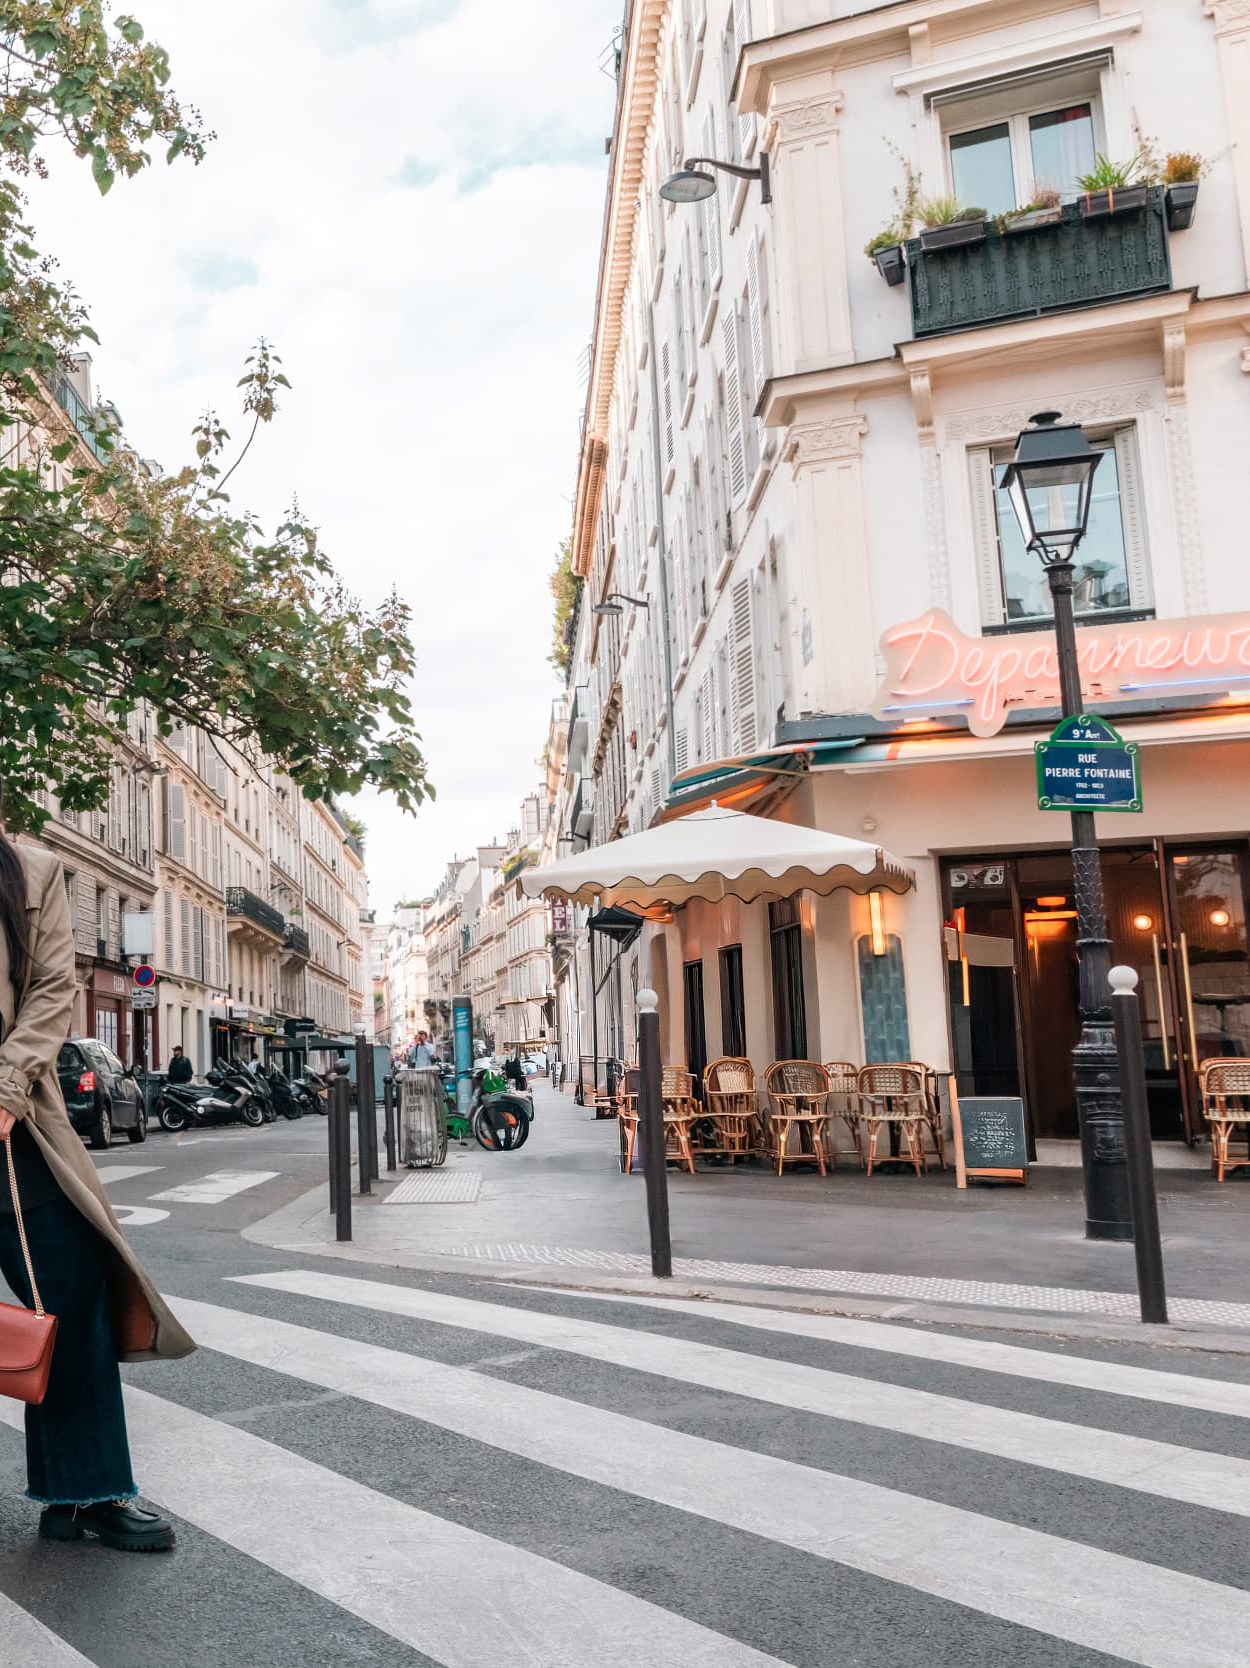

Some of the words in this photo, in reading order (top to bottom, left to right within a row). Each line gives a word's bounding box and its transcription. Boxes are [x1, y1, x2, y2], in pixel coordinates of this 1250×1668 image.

[1078, 754, 1098, 763] RUE
[1045, 768, 1081, 777] PIERRE
[1084, 769, 1132, 778] FONTAINE
